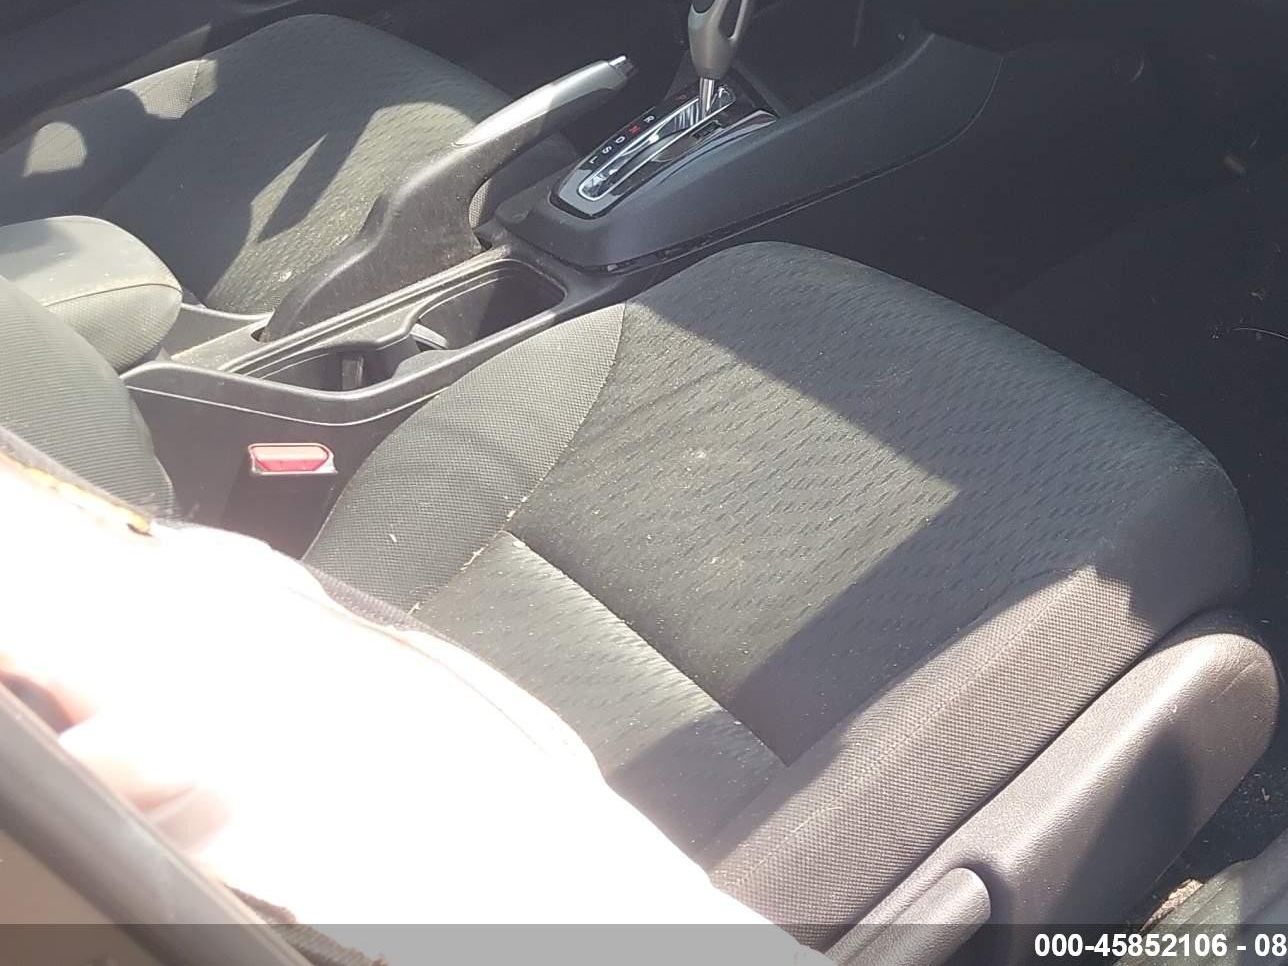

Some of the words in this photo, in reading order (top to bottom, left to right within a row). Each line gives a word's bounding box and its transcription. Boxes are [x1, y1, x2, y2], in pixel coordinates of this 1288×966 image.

[644, 115, 655, 124] R
[615, 135, 626, 144] D
[602, 146, 612, 155] S
[589, 156, 598, 164] L
